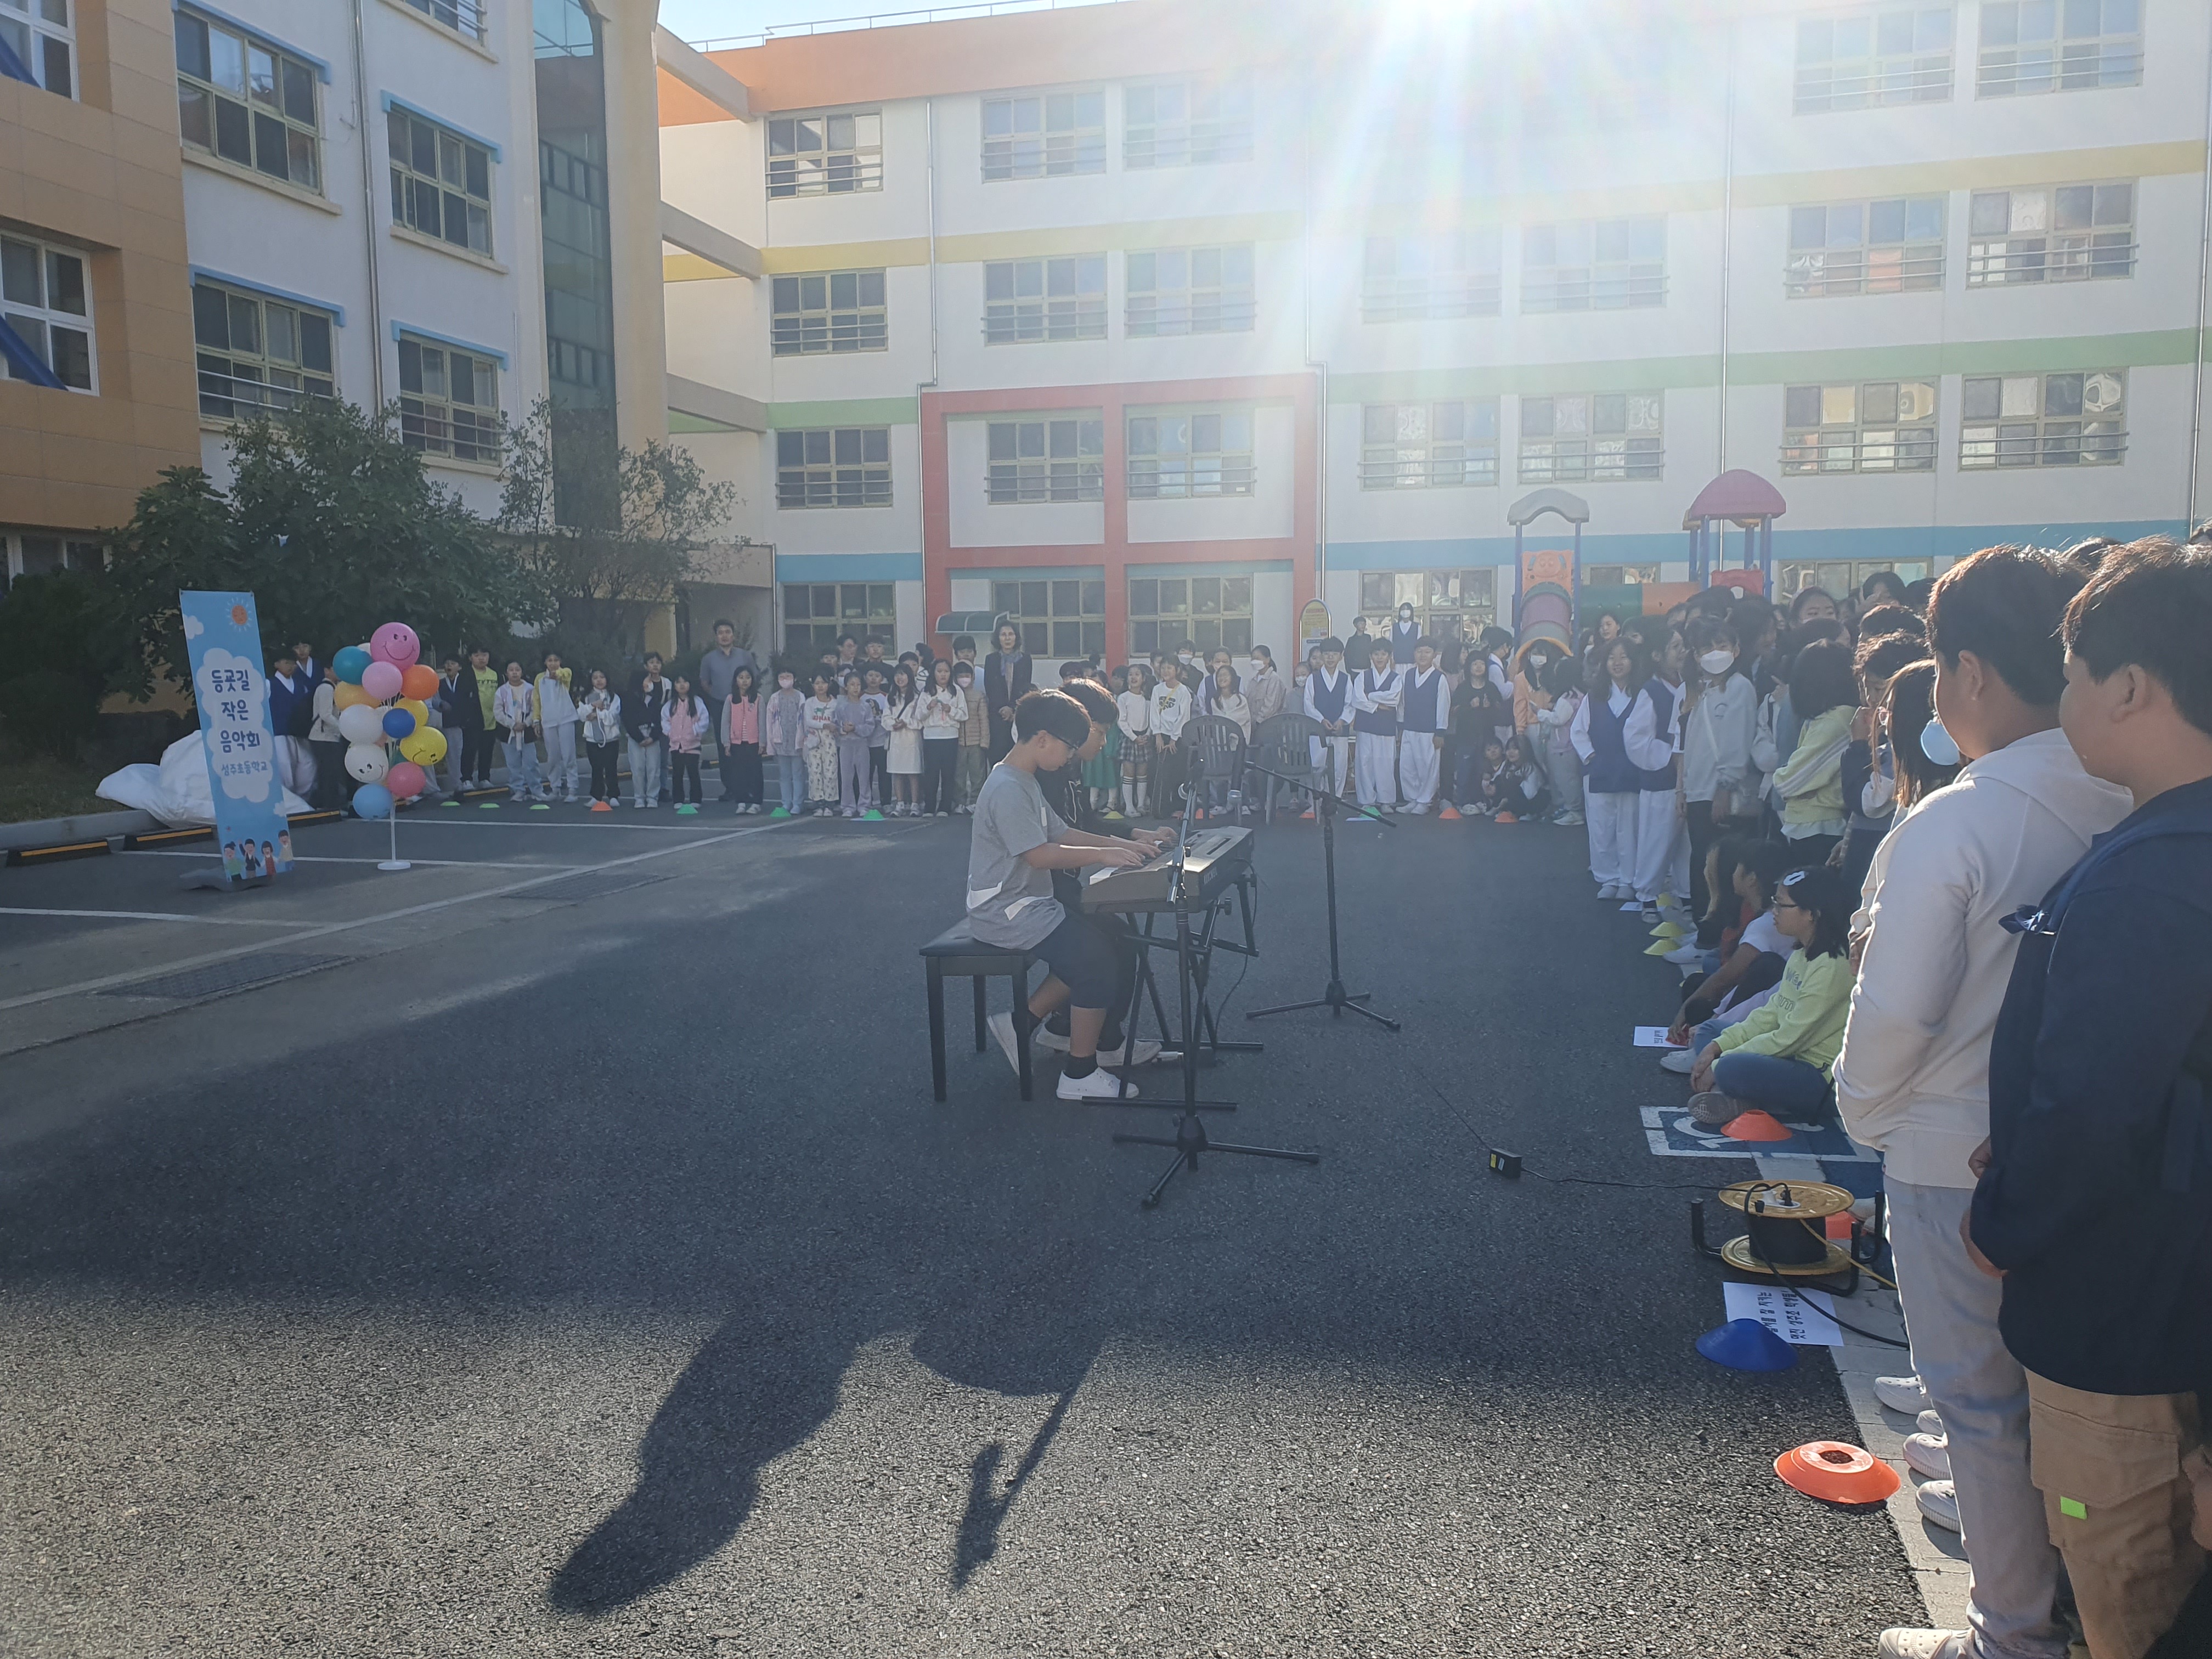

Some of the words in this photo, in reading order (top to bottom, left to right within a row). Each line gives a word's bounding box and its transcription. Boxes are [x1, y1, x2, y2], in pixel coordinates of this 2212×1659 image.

[211, 669, 251, 693] 등굣길
[221, 699, 249, 721] 작은
[220, 730, 261, 753] 음악회
[221, 760, 268, 776] 성주초등학교
[1757, 1292, 1773, 1306] 지키는
[1786, 1311, 1803, 1325] 성주초
[1789, 1329, 1806, 1339] 멋진
